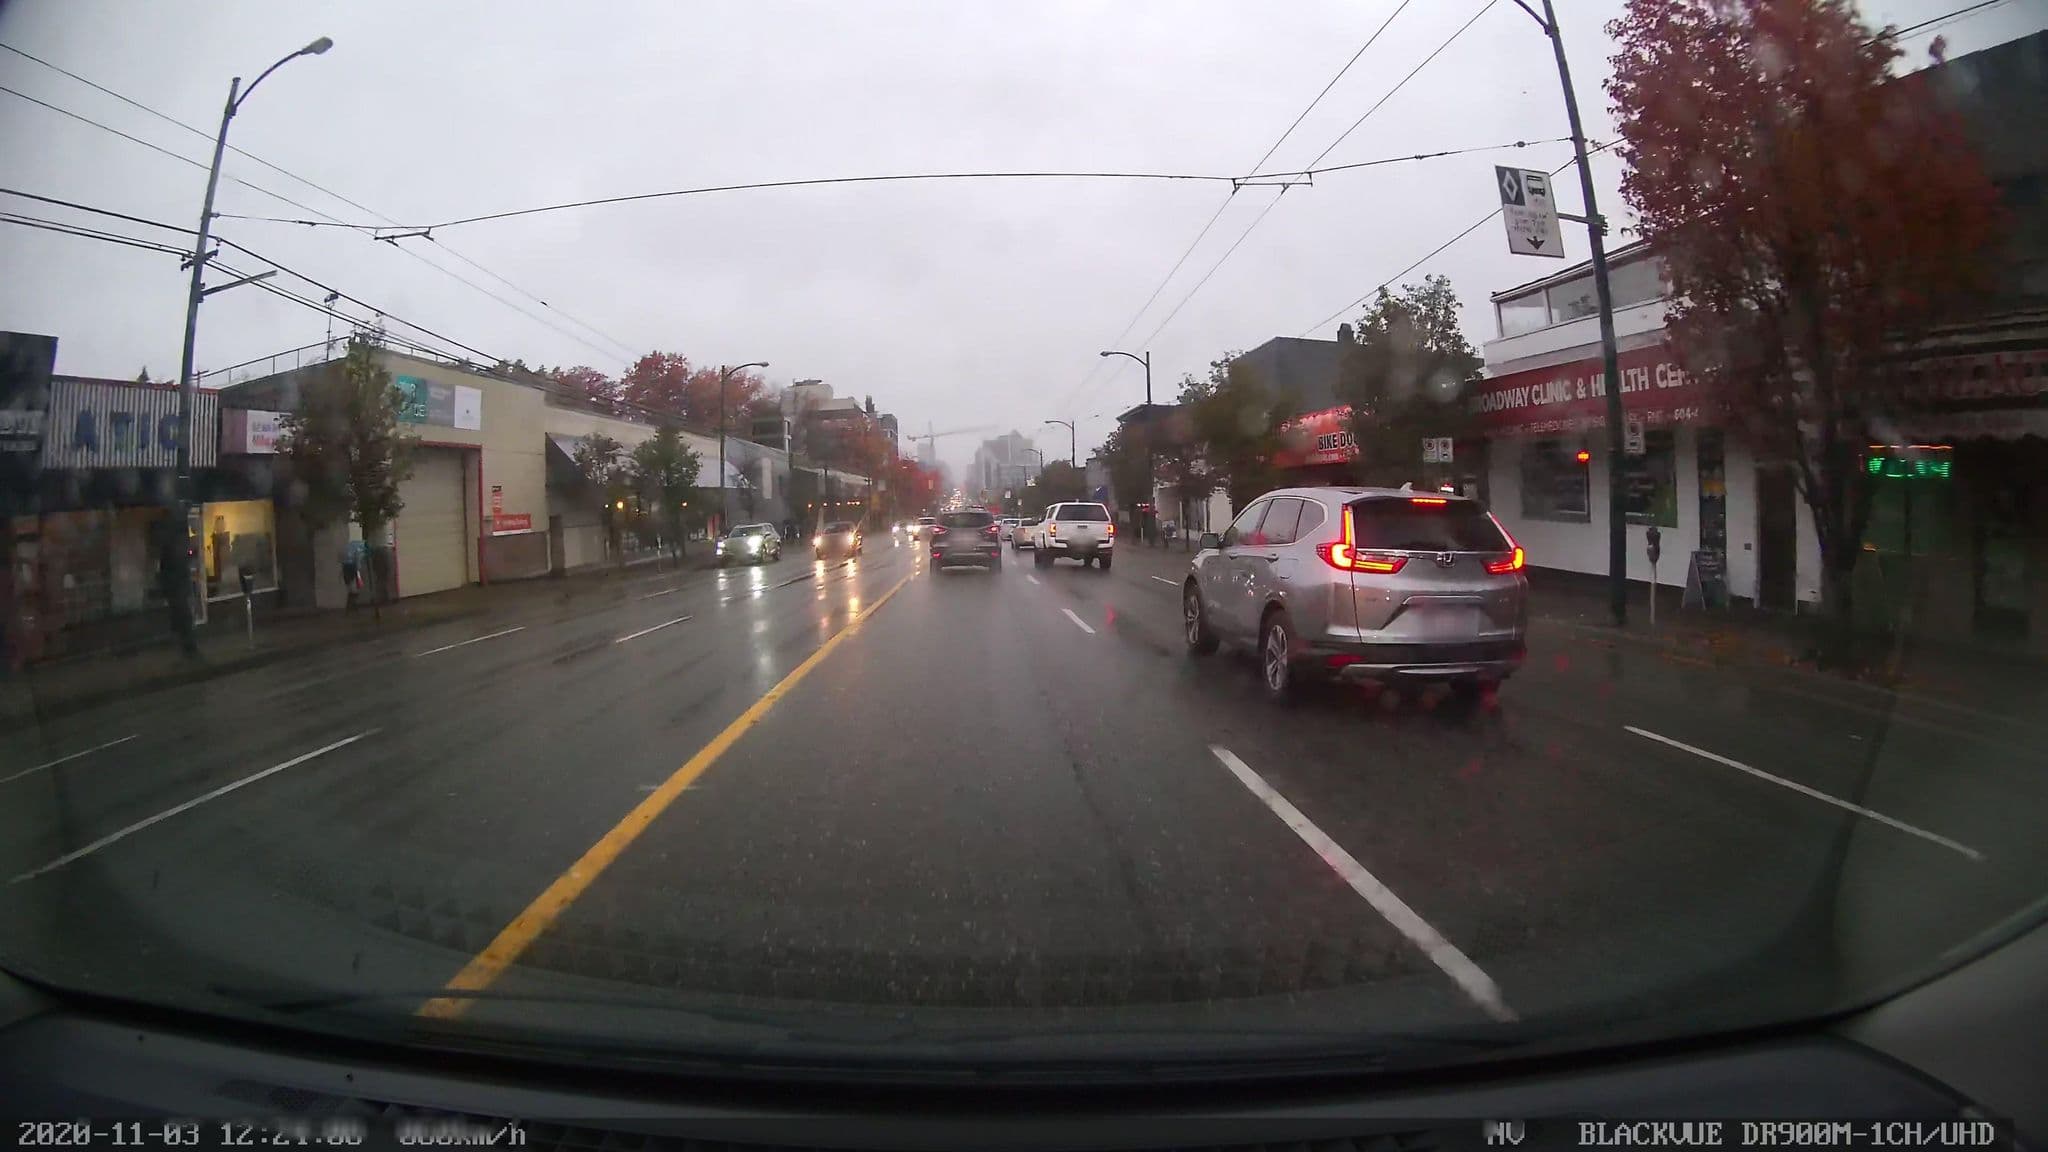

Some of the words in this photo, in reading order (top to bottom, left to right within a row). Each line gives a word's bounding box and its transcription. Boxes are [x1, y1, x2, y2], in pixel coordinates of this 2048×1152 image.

[1531, 378, 1572, 406] CLINIC
[1576, 377, 1587, 400] &
[1591, 366, 1650, 398] HLTH
[1318, 432, 1339, 451] BIKE
